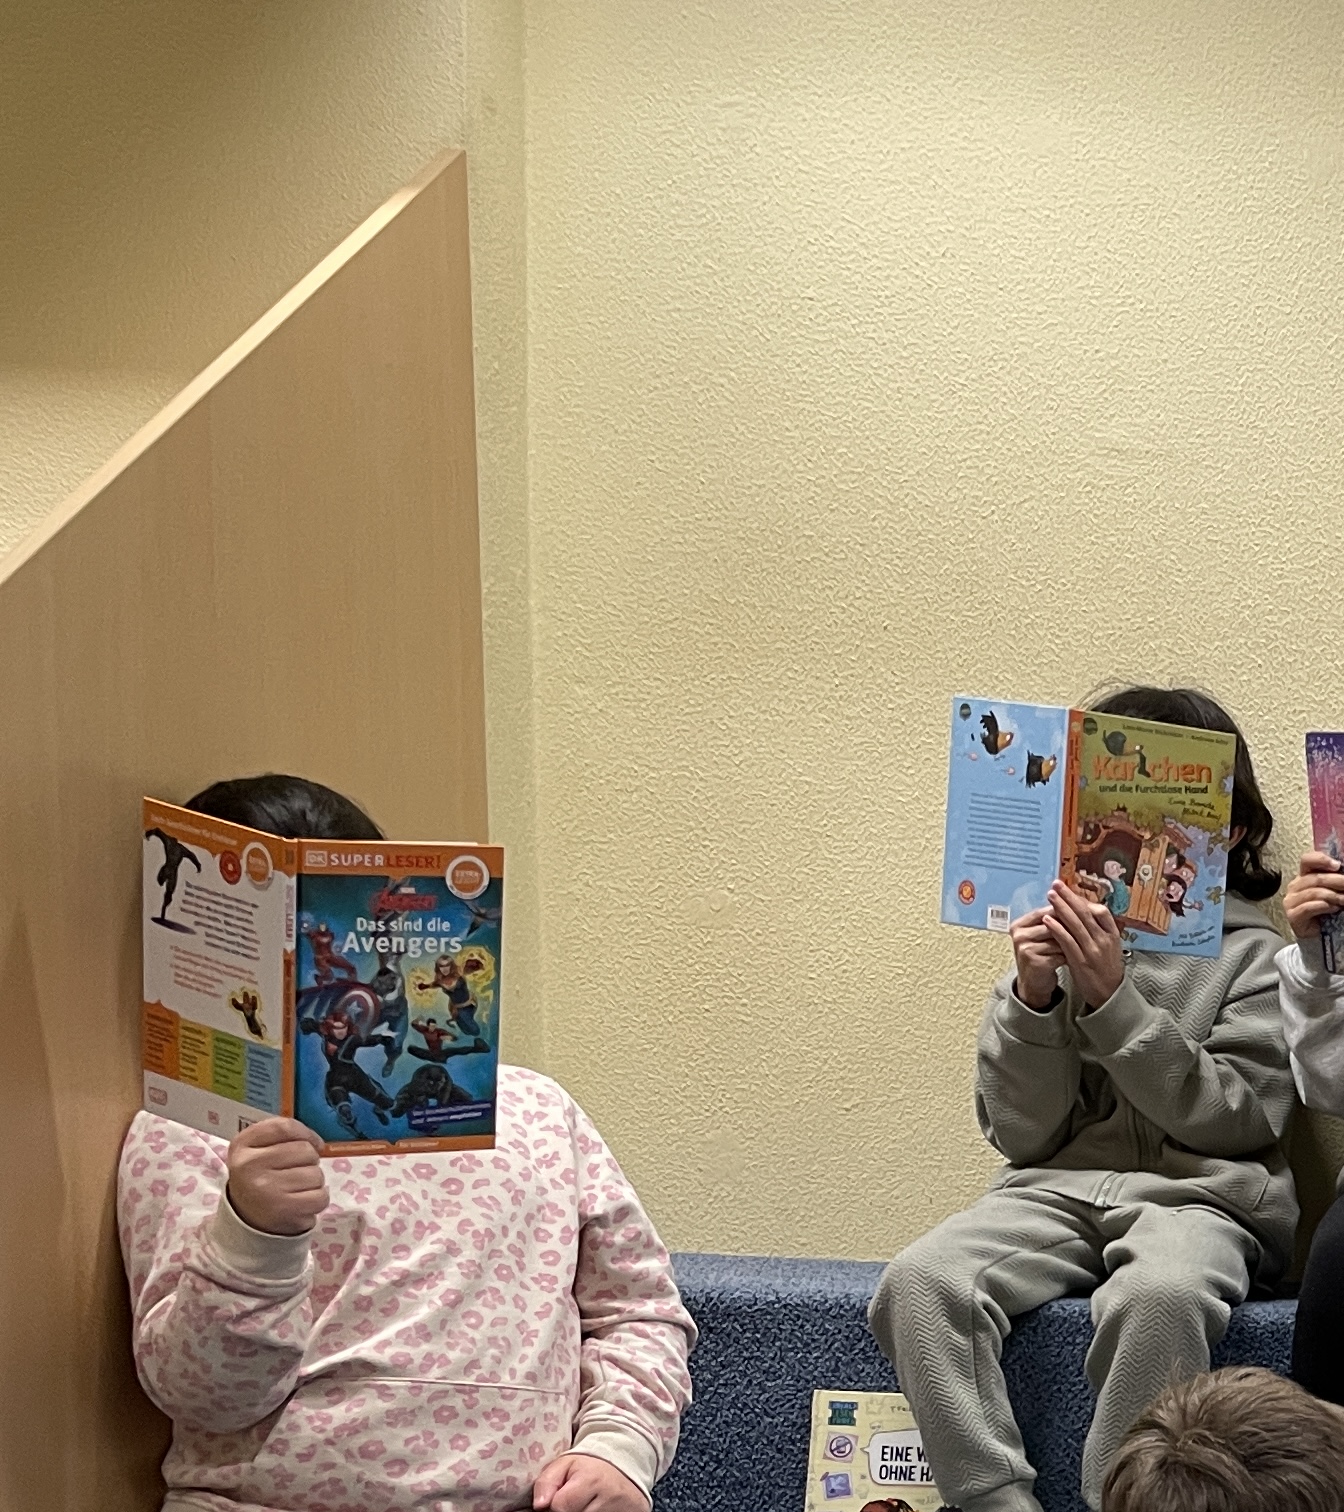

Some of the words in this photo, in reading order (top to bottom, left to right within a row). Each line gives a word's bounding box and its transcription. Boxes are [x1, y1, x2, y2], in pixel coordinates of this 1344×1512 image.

[356, 916, 386, 932] Das
[389, 916, 423, 932] sind
[426, 916, 451, 932] die
[341, 931, 463, 959] Avengers
[881, 1445, 914, 1462] EINE
[878, 1464, 917, 1482] OHNE
